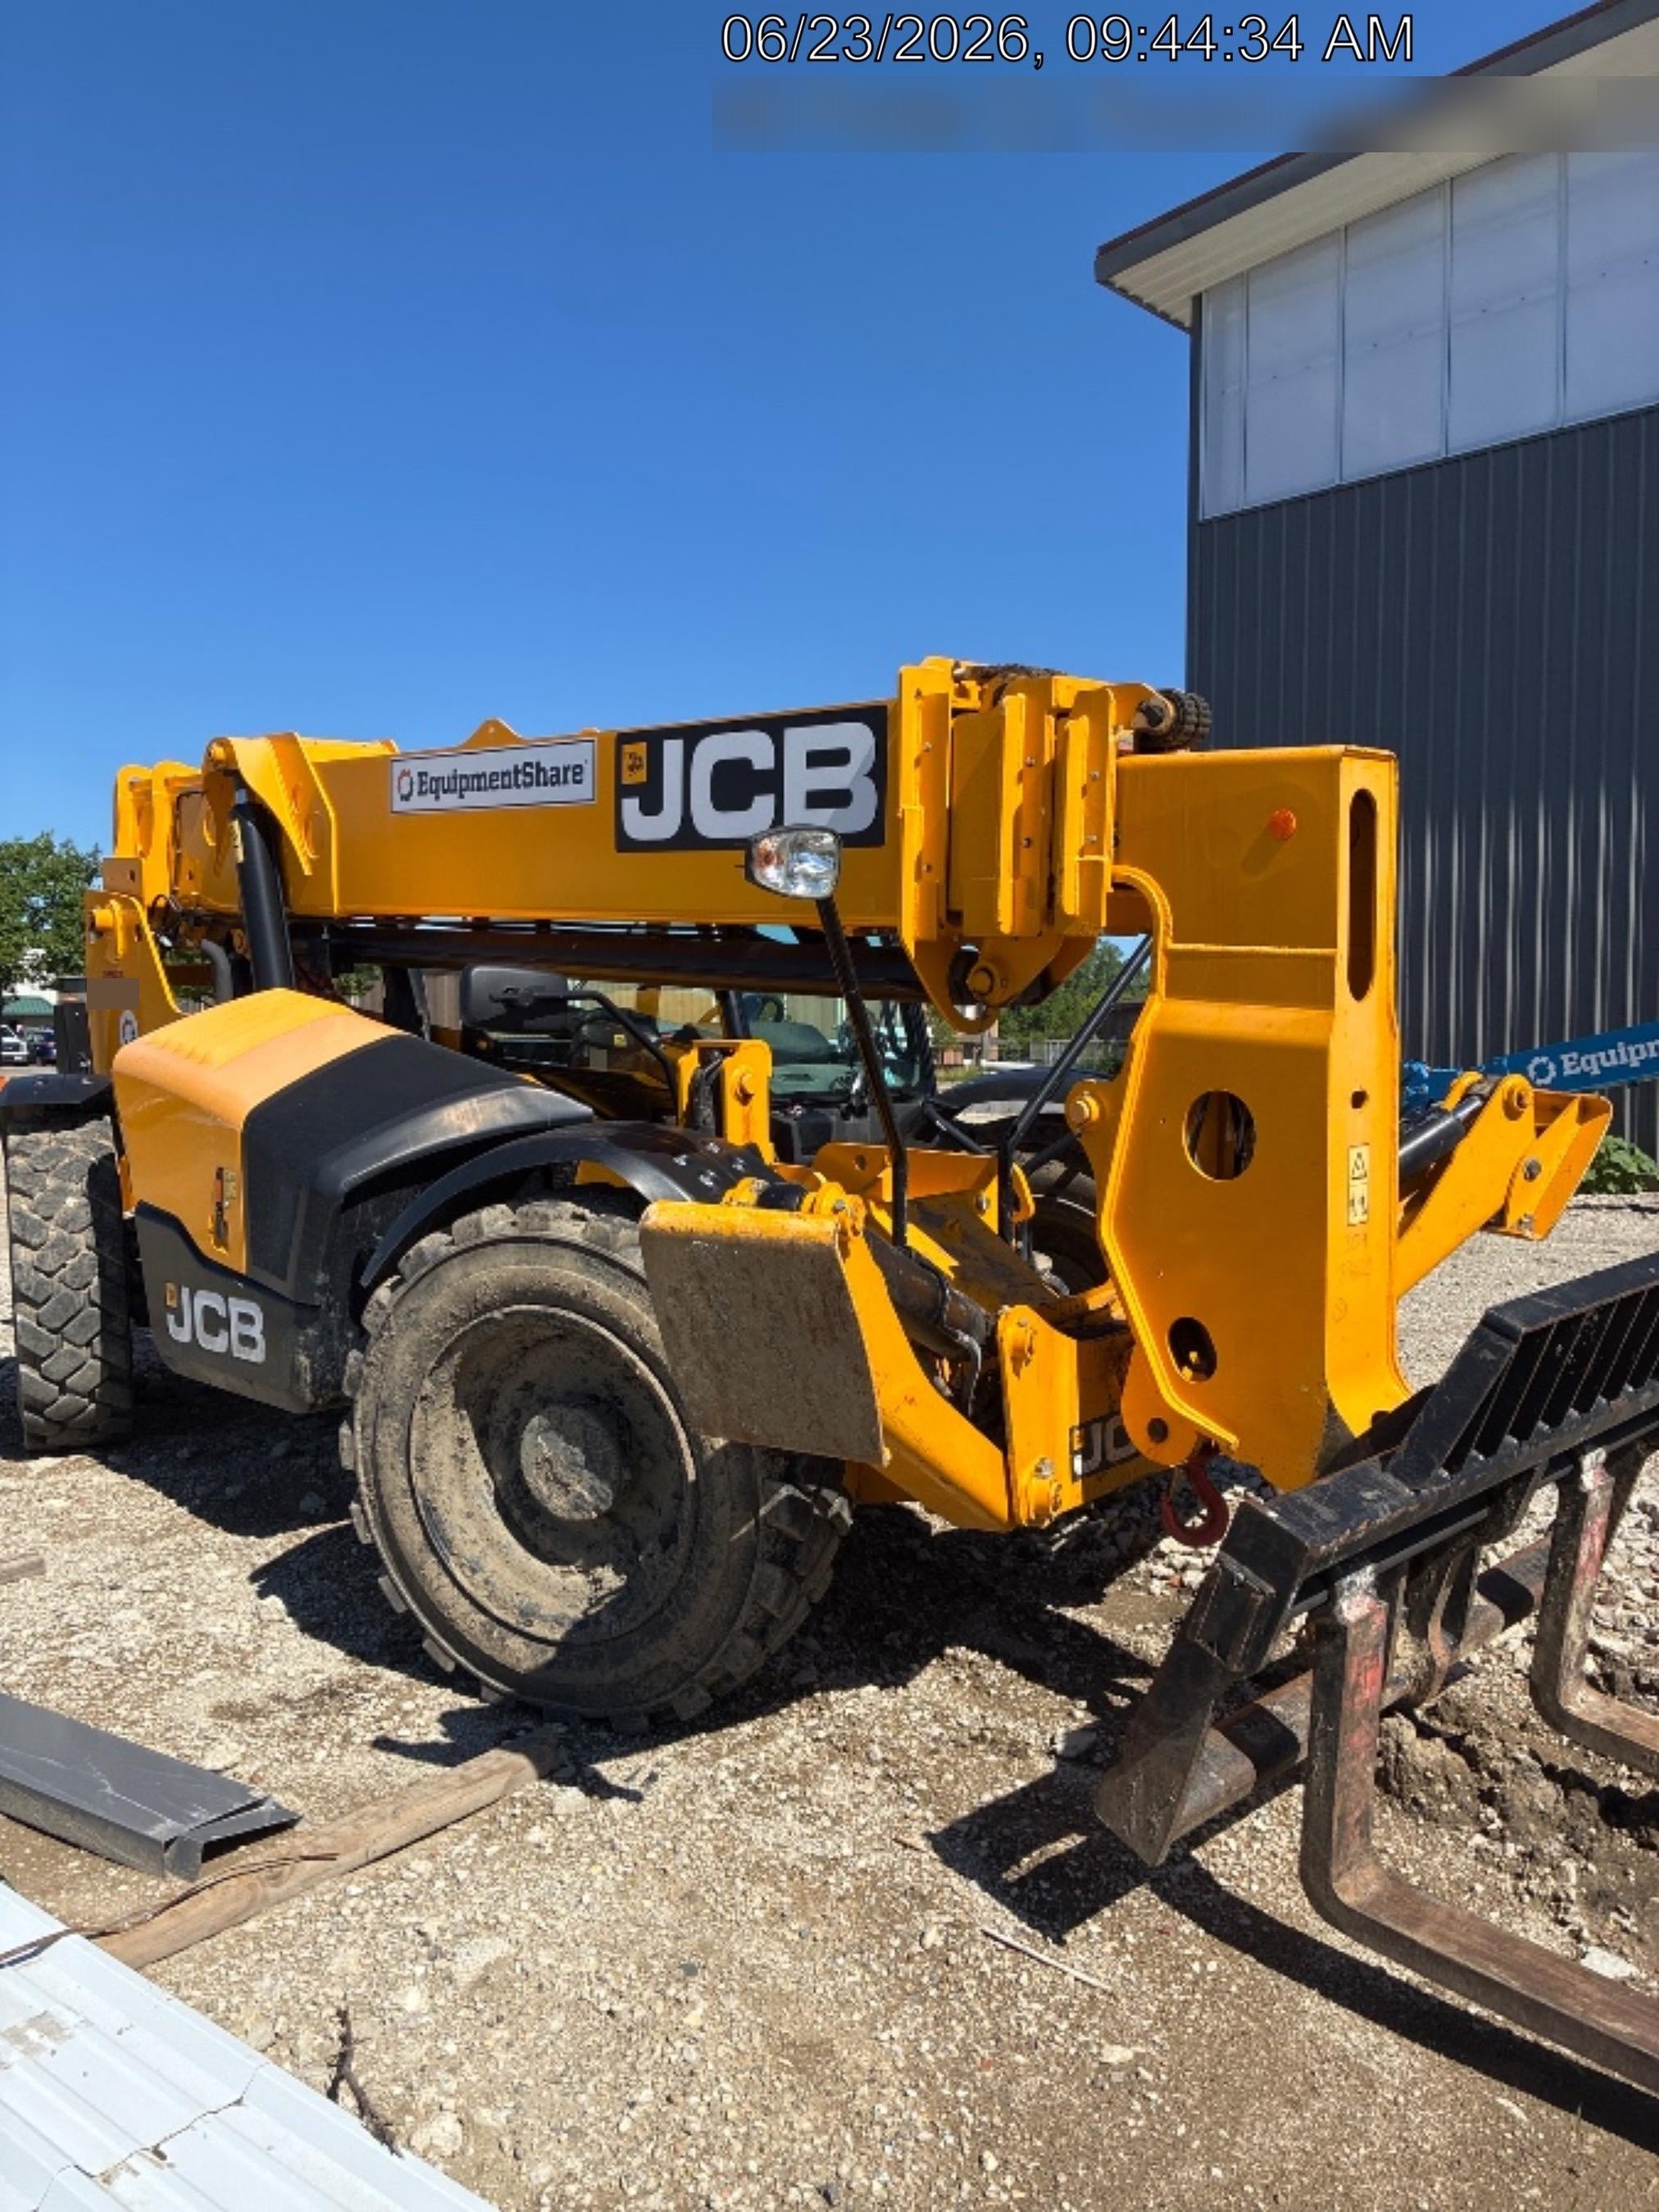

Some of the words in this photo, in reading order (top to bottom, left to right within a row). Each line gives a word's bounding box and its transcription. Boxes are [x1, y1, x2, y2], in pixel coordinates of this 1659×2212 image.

[417, 760, 583, 800] EquipmentShare
[621, 722, 877, 841] JCB
[166, 1285, 265, 1364] JCB
